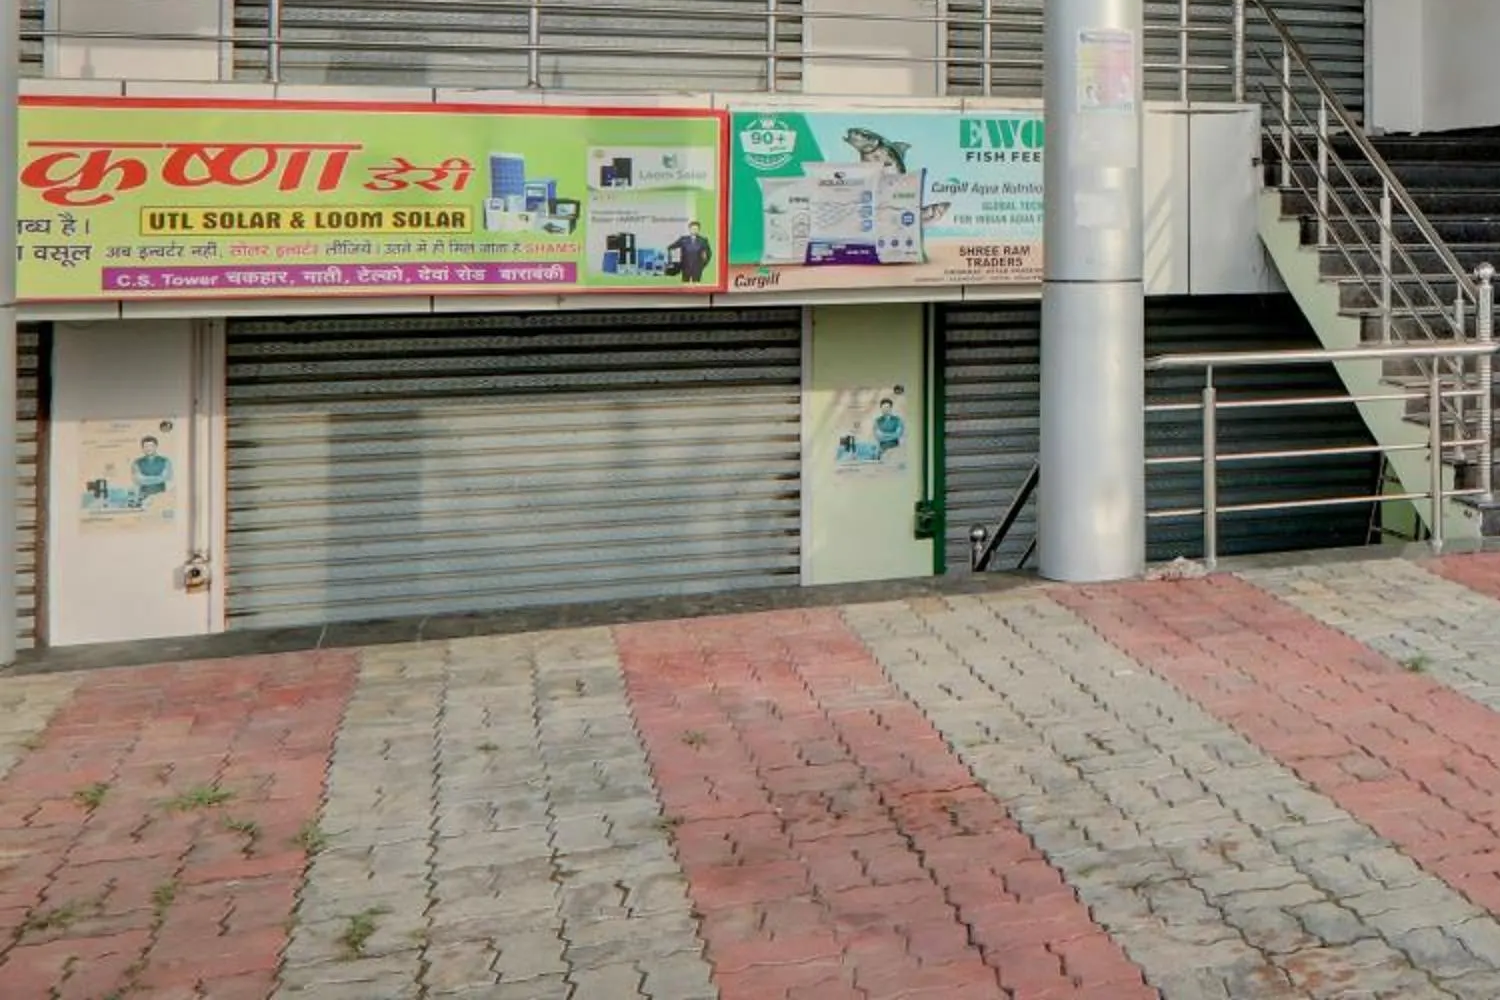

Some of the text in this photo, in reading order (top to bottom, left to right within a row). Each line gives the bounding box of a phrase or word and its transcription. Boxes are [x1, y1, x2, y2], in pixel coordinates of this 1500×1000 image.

[966, 151, 1005, 163] FISH
[150, 210, 466, 229] UTL SOLAR & LOOM SOLAR
[32, 245, 92, 268] वसूल
[959, 245, 1031, 257] SHREE RAM
[965, 257, 1023, 267] TRADERS
[161, 272, 219, 287] Tower
